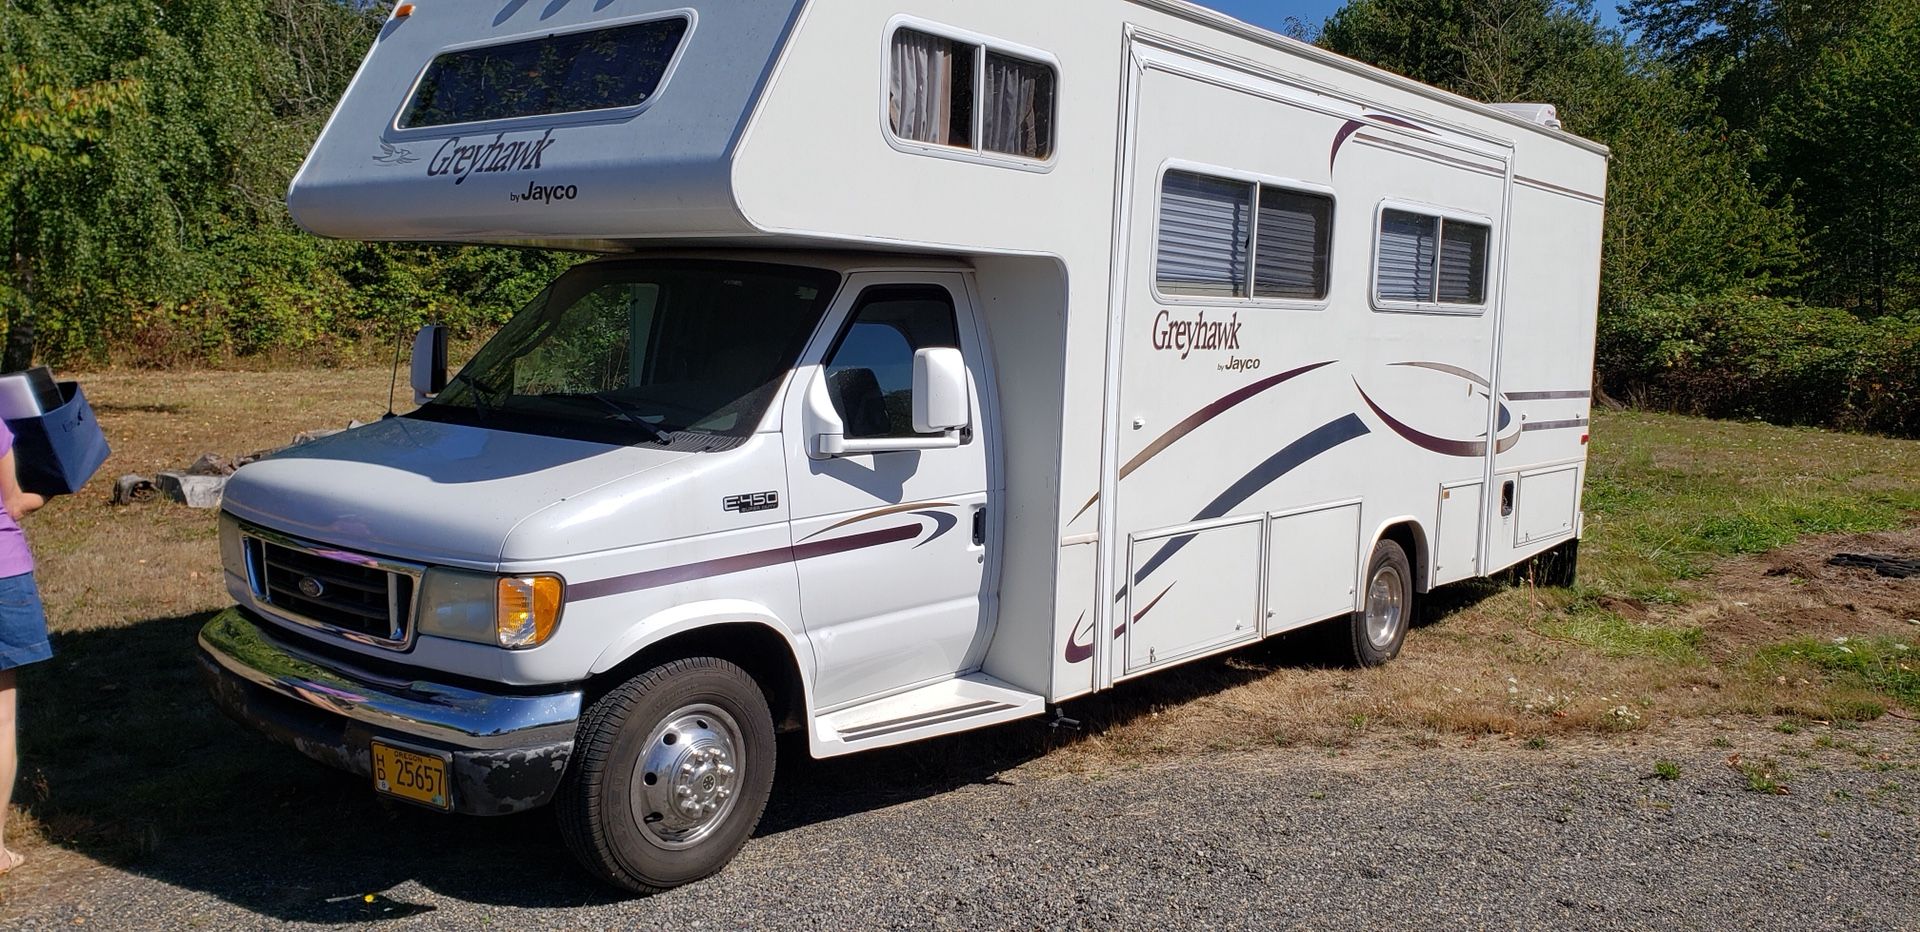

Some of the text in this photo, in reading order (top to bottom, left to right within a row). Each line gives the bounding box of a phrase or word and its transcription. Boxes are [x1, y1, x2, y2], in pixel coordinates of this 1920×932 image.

[427, 127, 556, 185] Greyhawk
[510, 181, 578, 205] by Jayco
[1152, 309, 1242, 360] Greyhawk
[1217, 355, 1260, 373] by Jayco
[394, 750, 423, 763] OREGON
[395, 758, 442, 796] 25657
